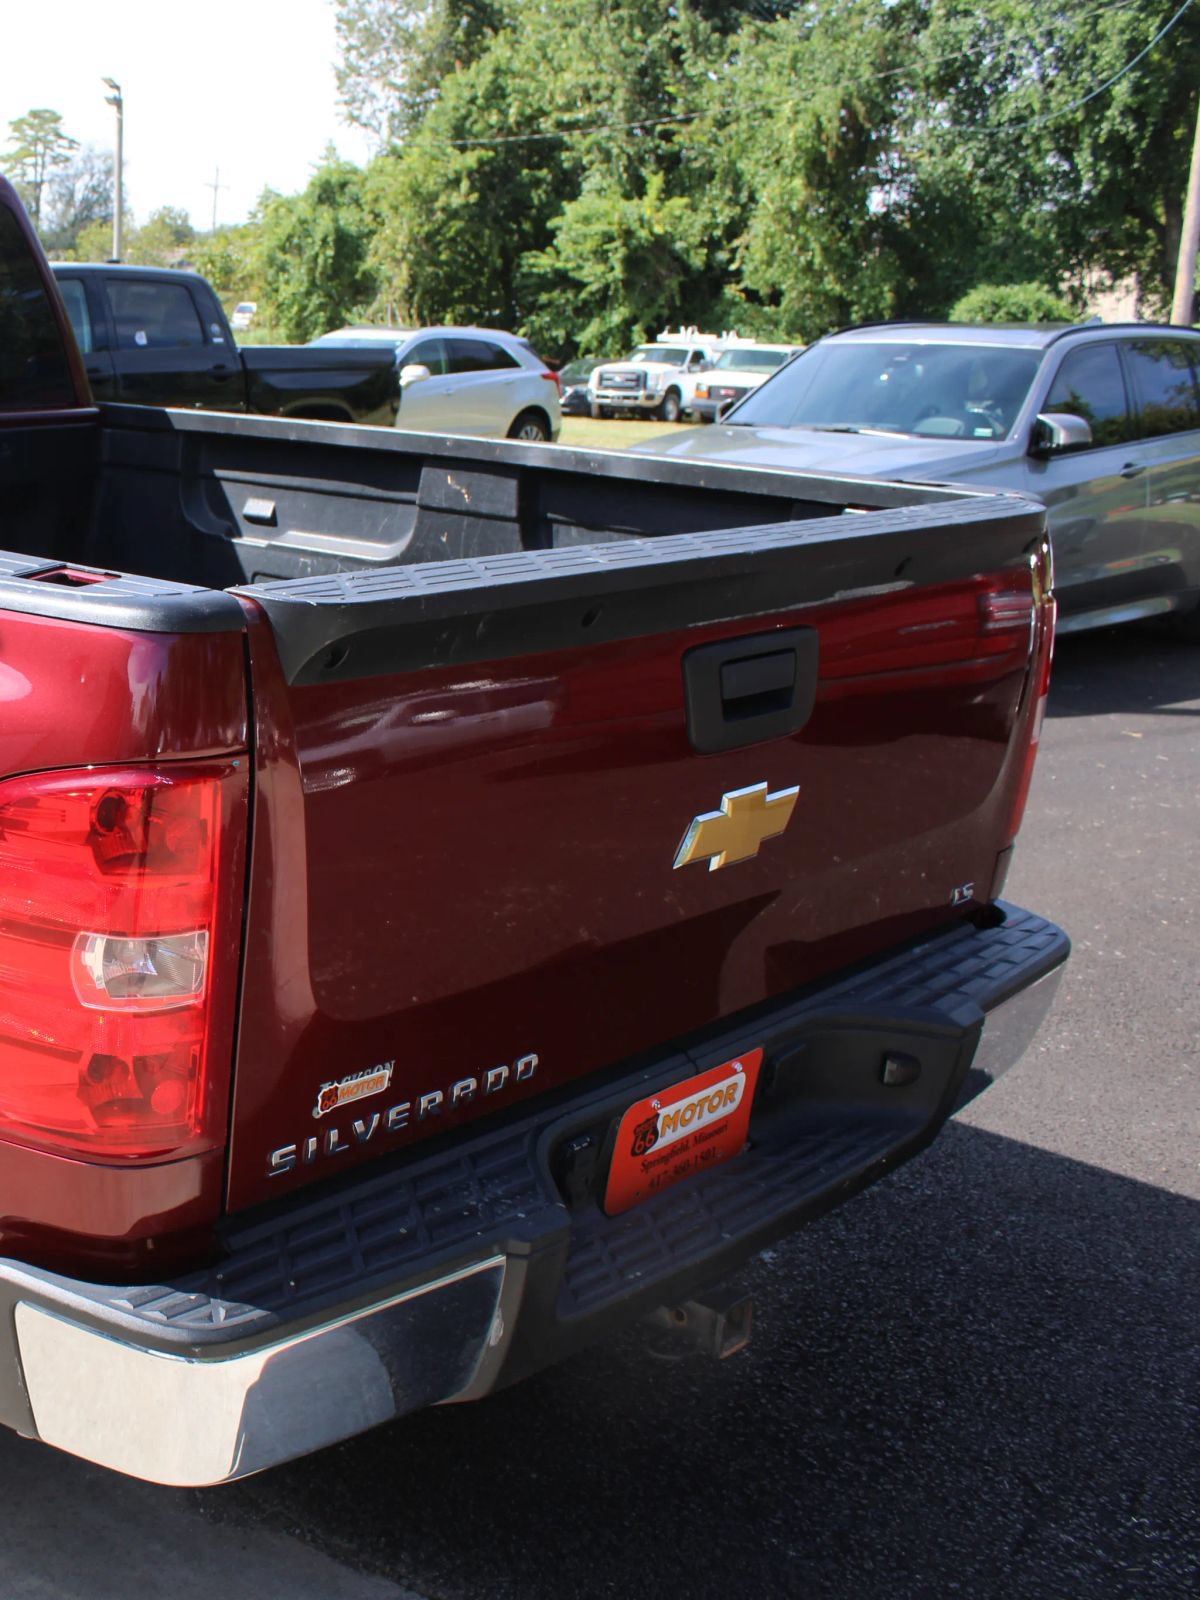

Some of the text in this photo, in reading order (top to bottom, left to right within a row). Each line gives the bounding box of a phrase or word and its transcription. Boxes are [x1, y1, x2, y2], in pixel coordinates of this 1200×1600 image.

[268, 1053, 538, 1176] SILVERADO
[634, 1126, 655, 1153] 66
[660, 1082, 738, 1138] MOTOR
